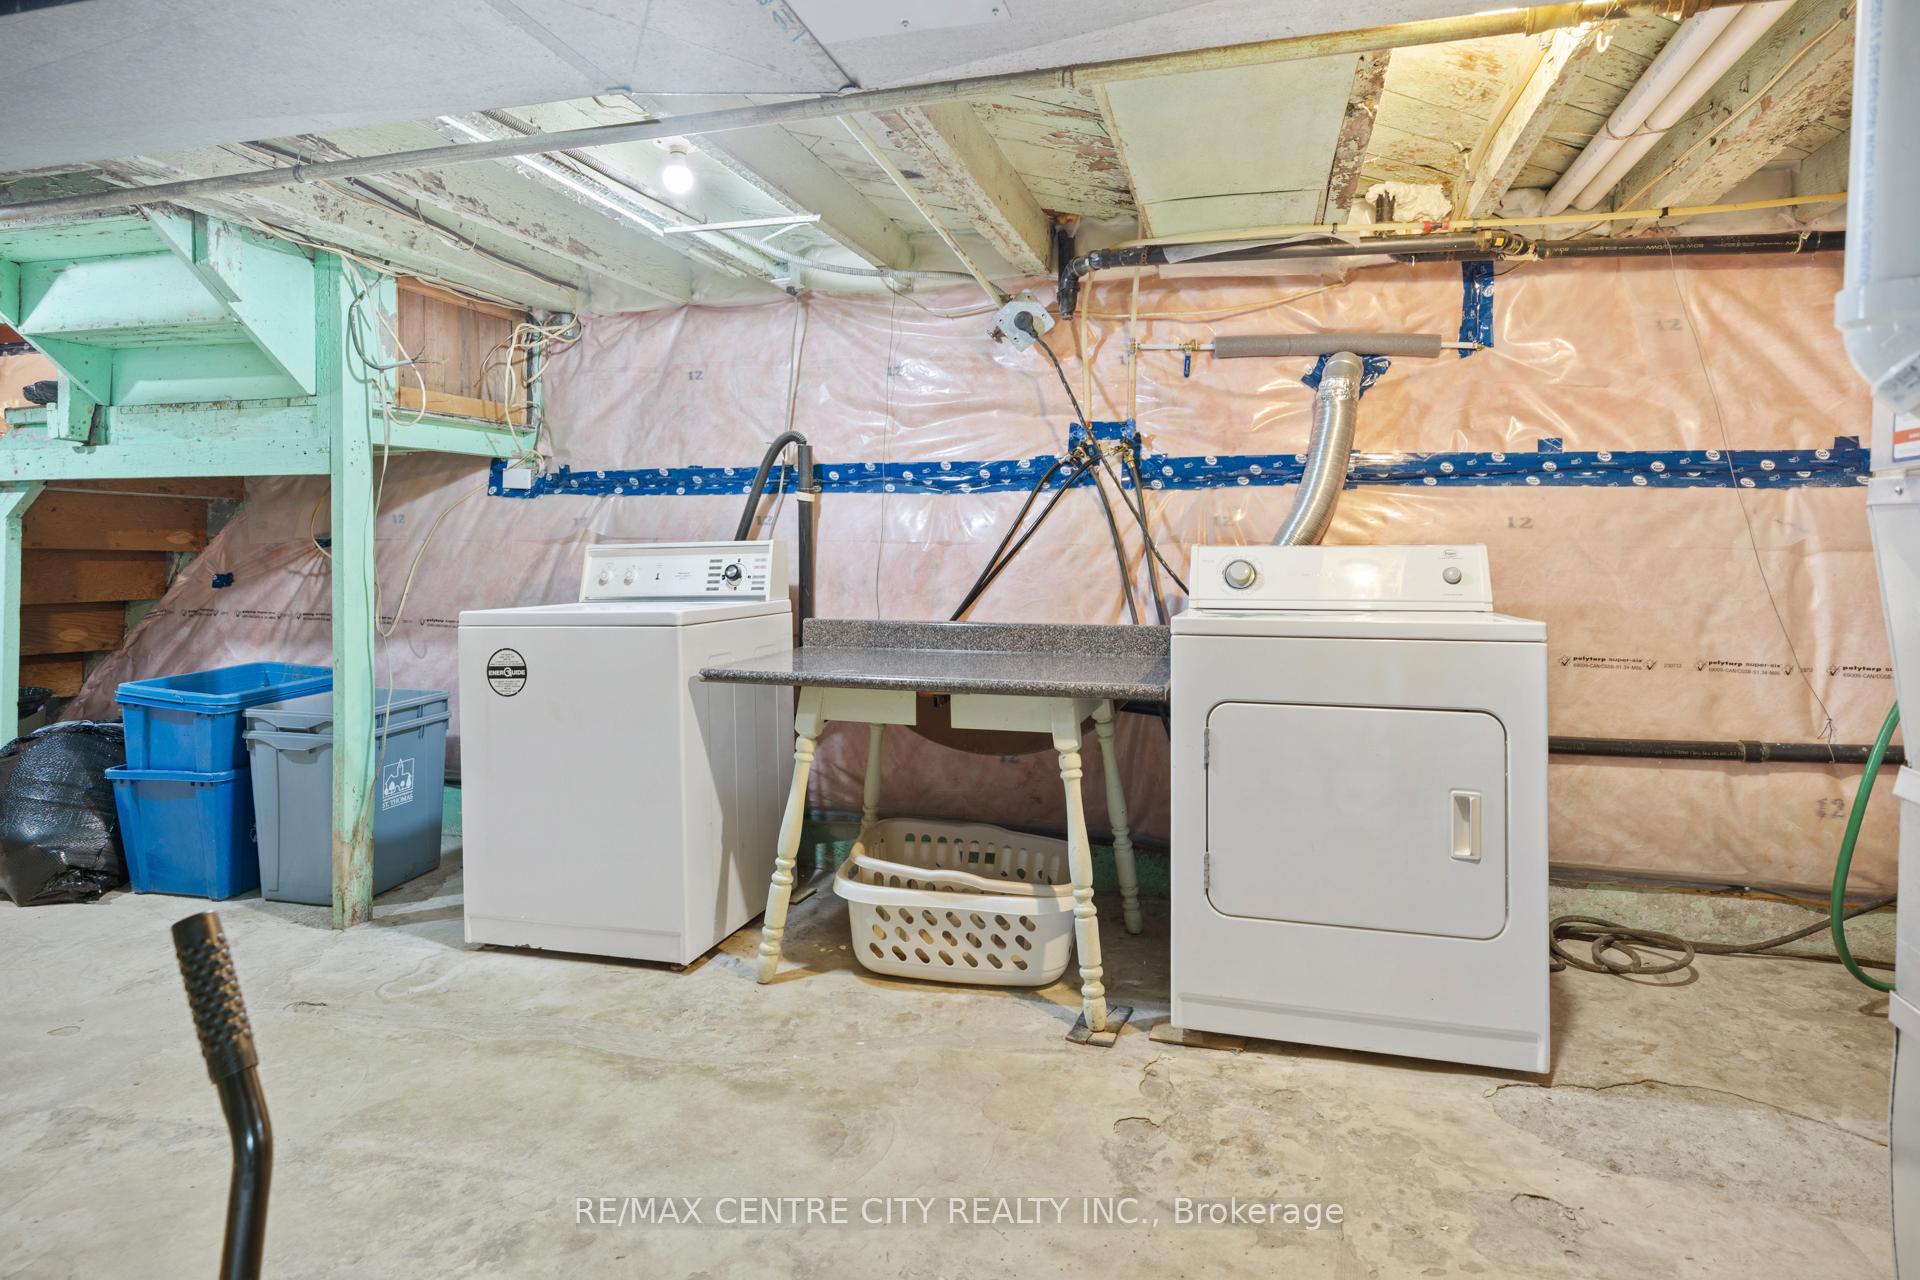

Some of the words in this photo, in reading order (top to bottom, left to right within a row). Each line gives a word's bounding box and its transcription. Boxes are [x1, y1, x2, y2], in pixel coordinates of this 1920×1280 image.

[688, 370, 704, 381] 12
[1507, 516, 1535, 529] 12
[1842, 665, 1882, 673] polytarp
[390, 793, 414, 806] THOMAS
